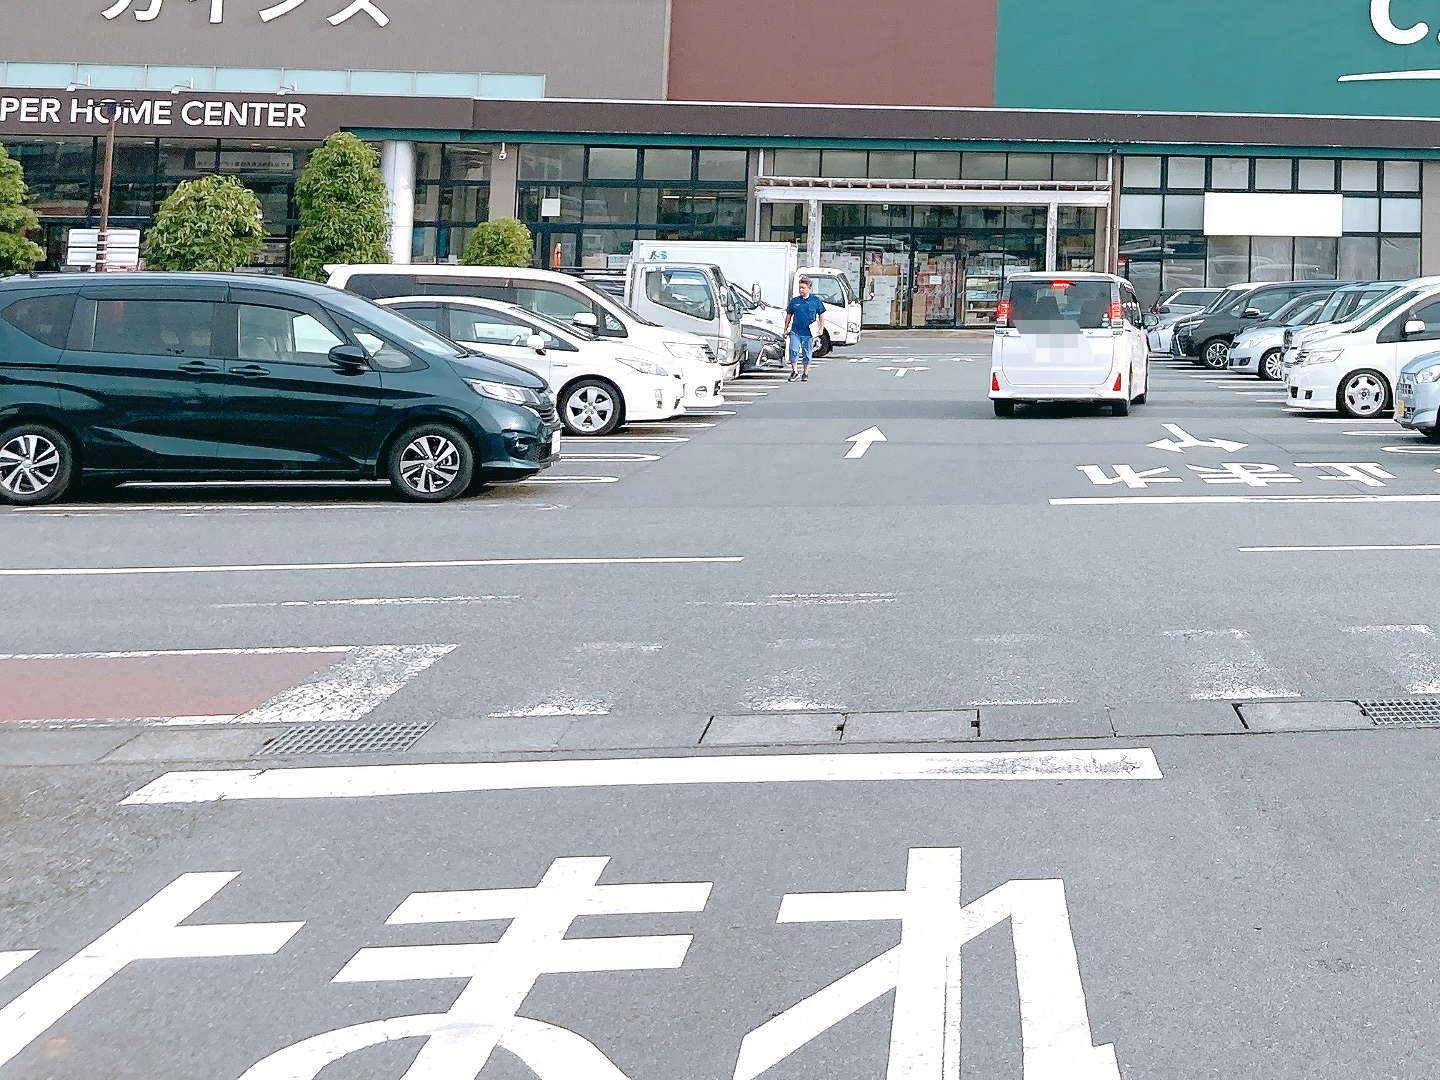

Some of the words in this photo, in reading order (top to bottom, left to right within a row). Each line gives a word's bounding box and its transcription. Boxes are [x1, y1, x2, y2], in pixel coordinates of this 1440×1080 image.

[0, 97, 61, 123] PER
[70, 98, 172, 125] HOME
[181, 99, 307, 128] CENTER
